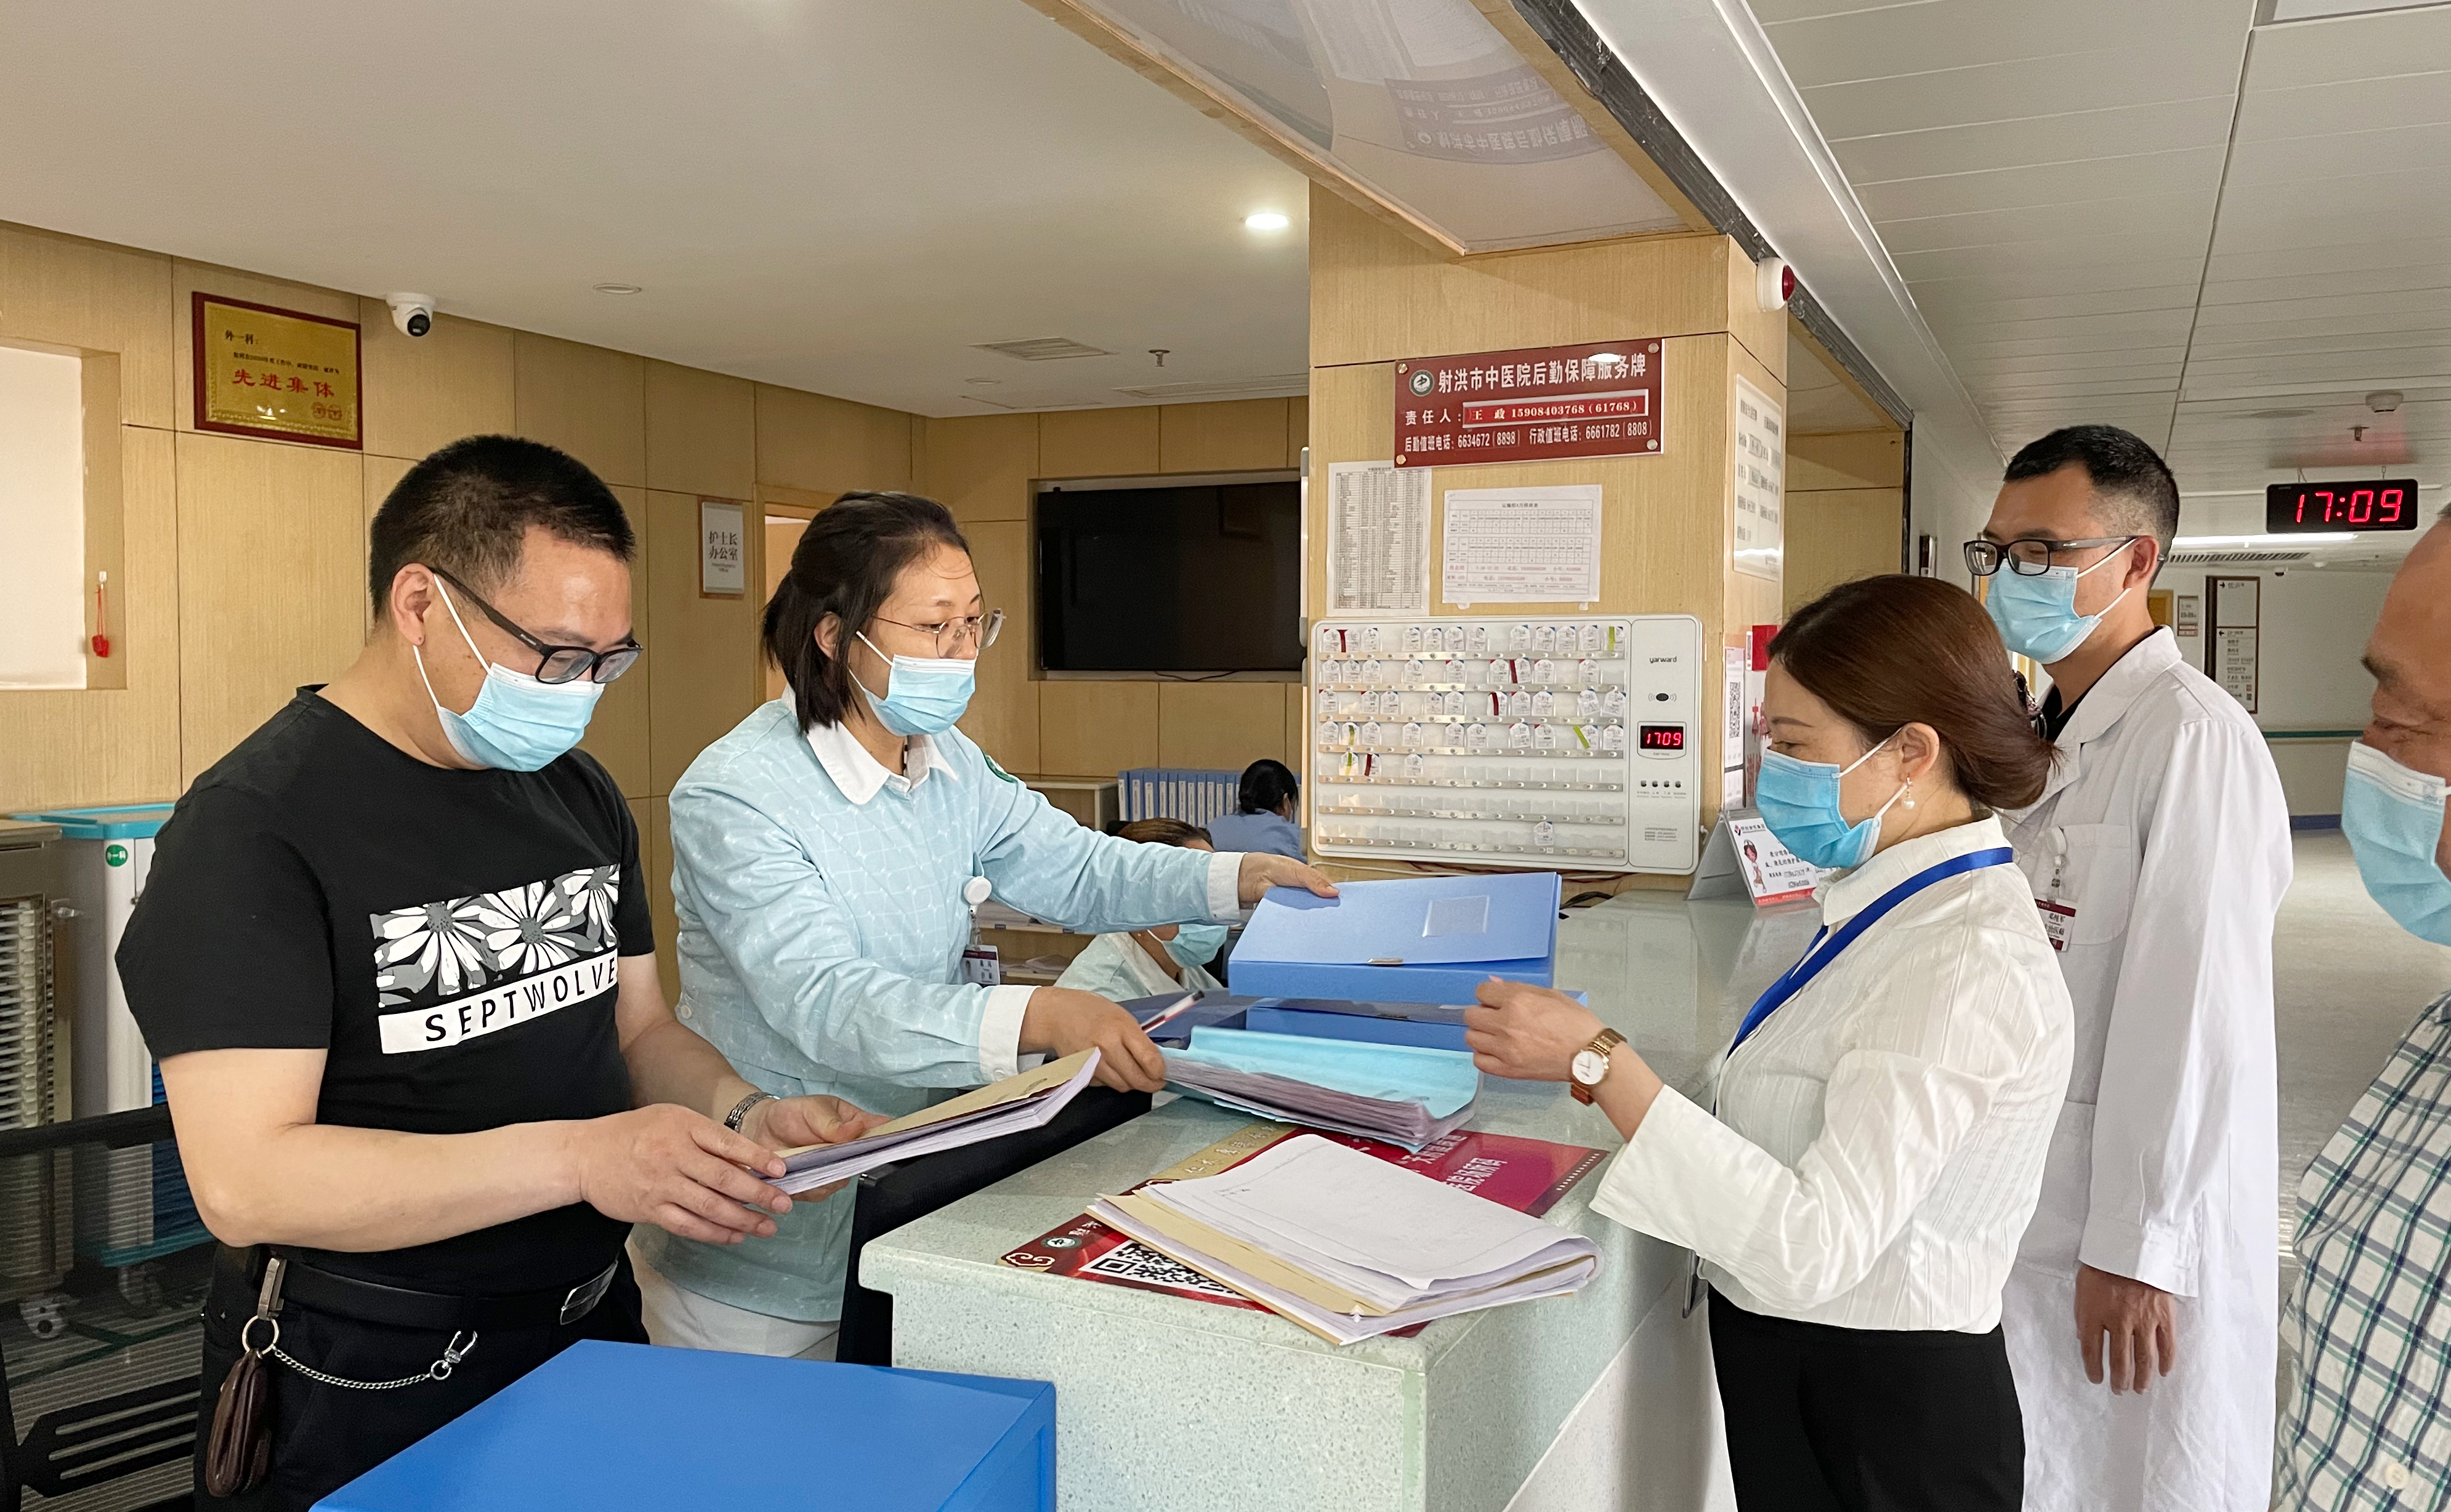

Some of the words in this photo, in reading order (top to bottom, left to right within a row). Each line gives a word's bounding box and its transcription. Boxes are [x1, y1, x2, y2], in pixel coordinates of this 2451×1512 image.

[232, 369, 335, 398] 先进集体
[1438, 353, 1647, 393] 射洪市中医院后勤保障服务牌
[2296, 489, 2403, 523] 17:09
[709, 531, 737, 545] 护士长
[709, 546, 738, 561] 办公室
[1649, 655, 1677, 664] yarward
[1646, 731, 1682, 746] 1709
[425, 957, 616, 1042] SEPTWOLVE
